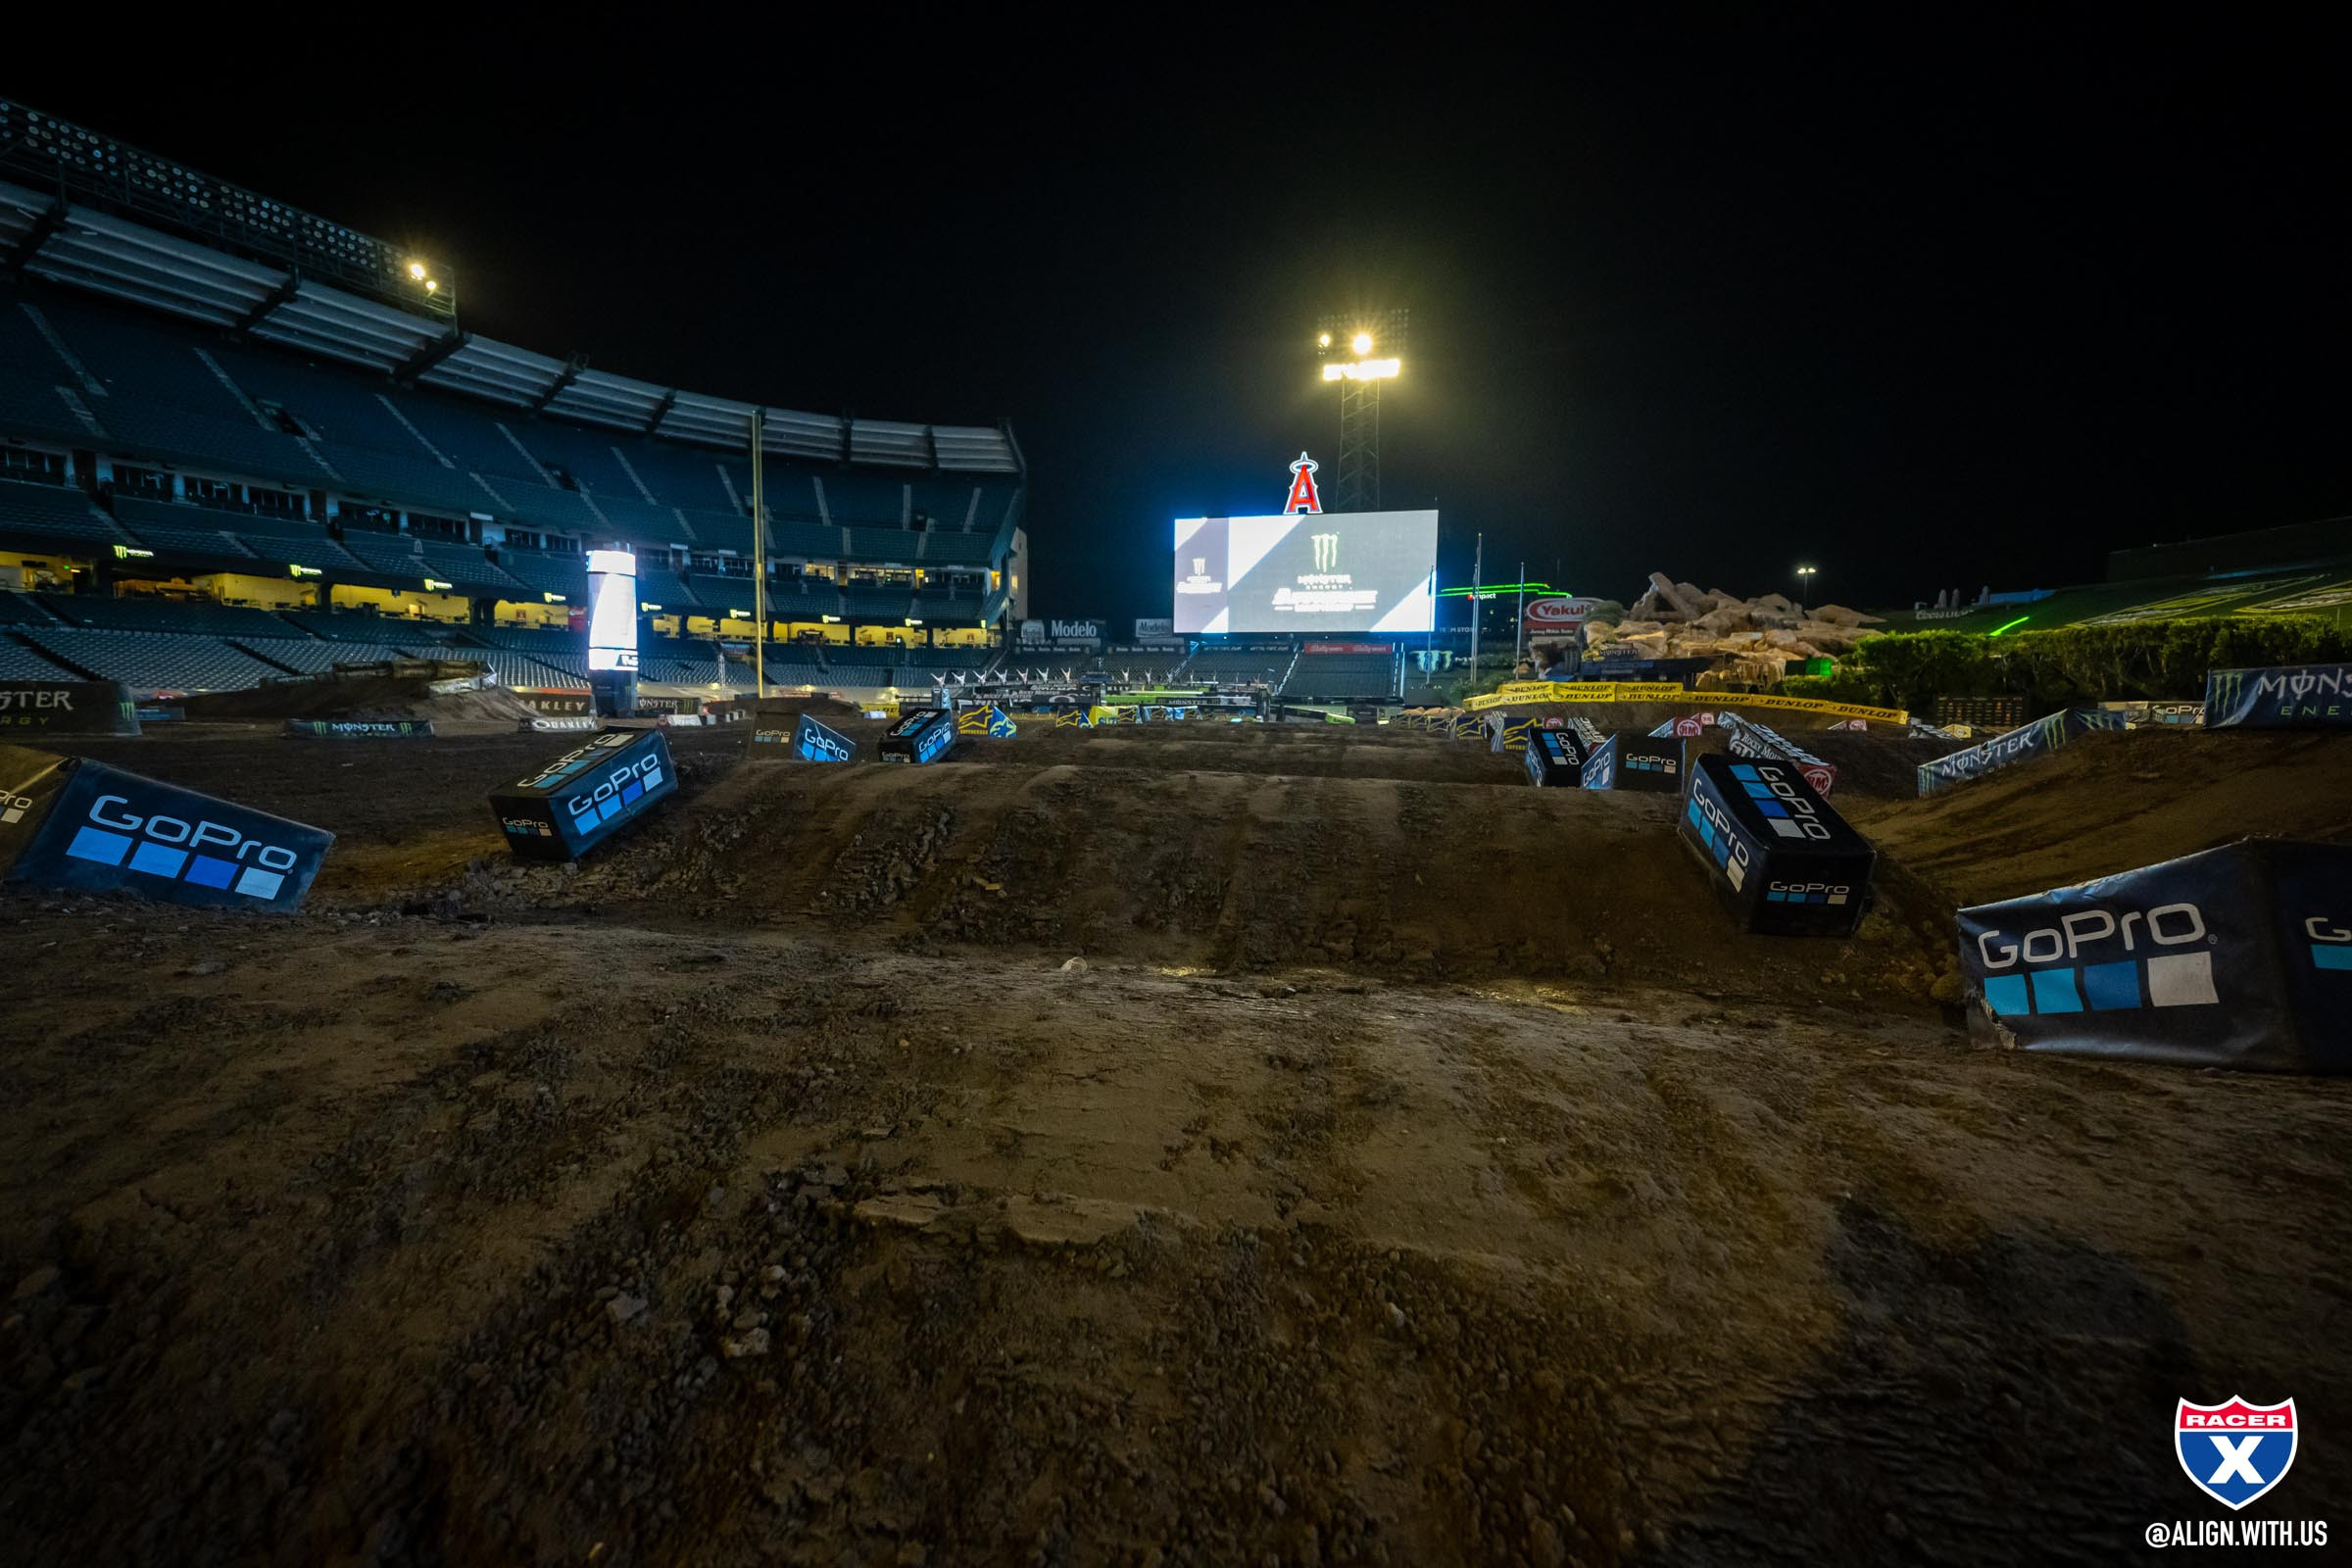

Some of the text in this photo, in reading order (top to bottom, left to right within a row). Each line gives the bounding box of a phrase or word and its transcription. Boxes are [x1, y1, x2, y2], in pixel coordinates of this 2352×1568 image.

[1543, 605, 1585, 615] Yakul
[1051, 619, 1098, 637] Modelo
[1695, 695, 1750, 704] DUNLOP
[1765, 699, 1825, 709] DUNLOP
[1838, 705, 1898, 720] DUNLOP
[331, 721, 395, 732] MONSTER
[756, 729, 791, 738] GoPro
[889, 710, 928, 737] GoPro
[917, 721, 952, 752] GoPro
[805, 728, 849, 761] GoPro
[1555, 732, 1581, 765] GoPro
[1941, 732, 2035, 777] MONSTER
[517, 733, 616, 788] GoPro
[1583, 752, 1610, 787] GoPro
[1626, 753, 1677, 766] GoPro
[567, 754, 658, 815] GoPro
[1757, 765, 1832, 840] GoPro
[88, 794, 298, 872] GoPro
[503, 817, 550, 829] GoPro
[1692, 778, 1749, 868] GoPro
[1769, 881, 1850, 894] GoPro
[1977, 903, 2207, 969] GoPro
